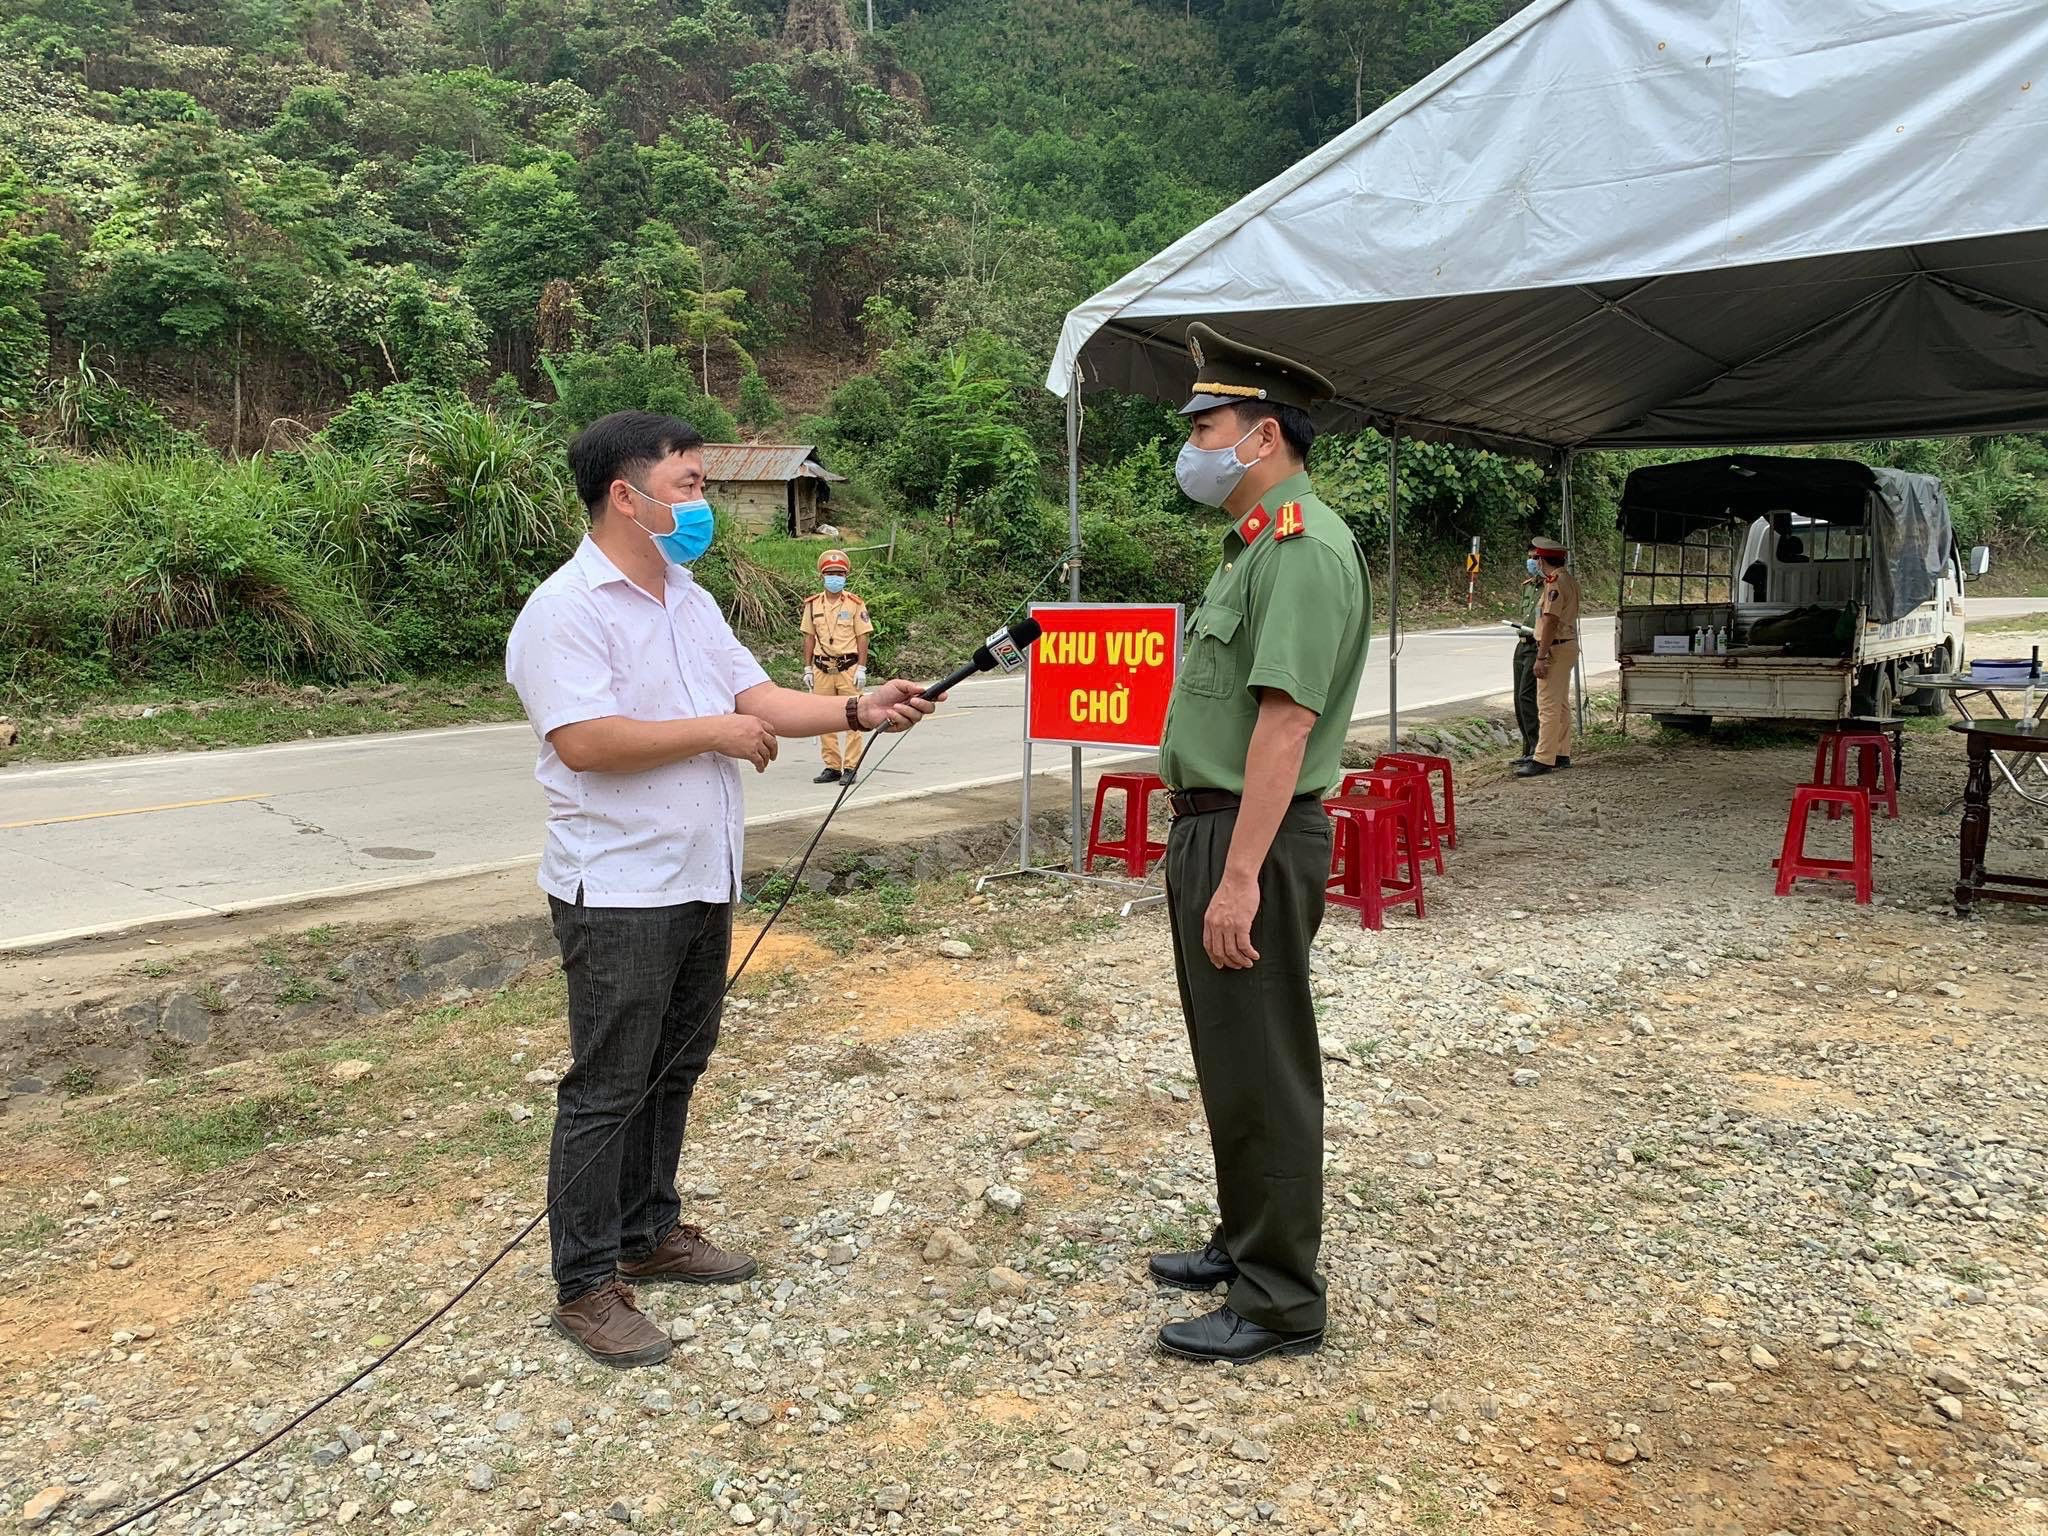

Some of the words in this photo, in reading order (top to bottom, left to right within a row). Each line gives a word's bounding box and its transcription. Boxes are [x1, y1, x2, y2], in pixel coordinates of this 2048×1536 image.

[1040, 631, 1096, 665] KHU
[1105, 629, 1165, 673] VỰC
[1069, 682, 1129, 725] CHỜ
